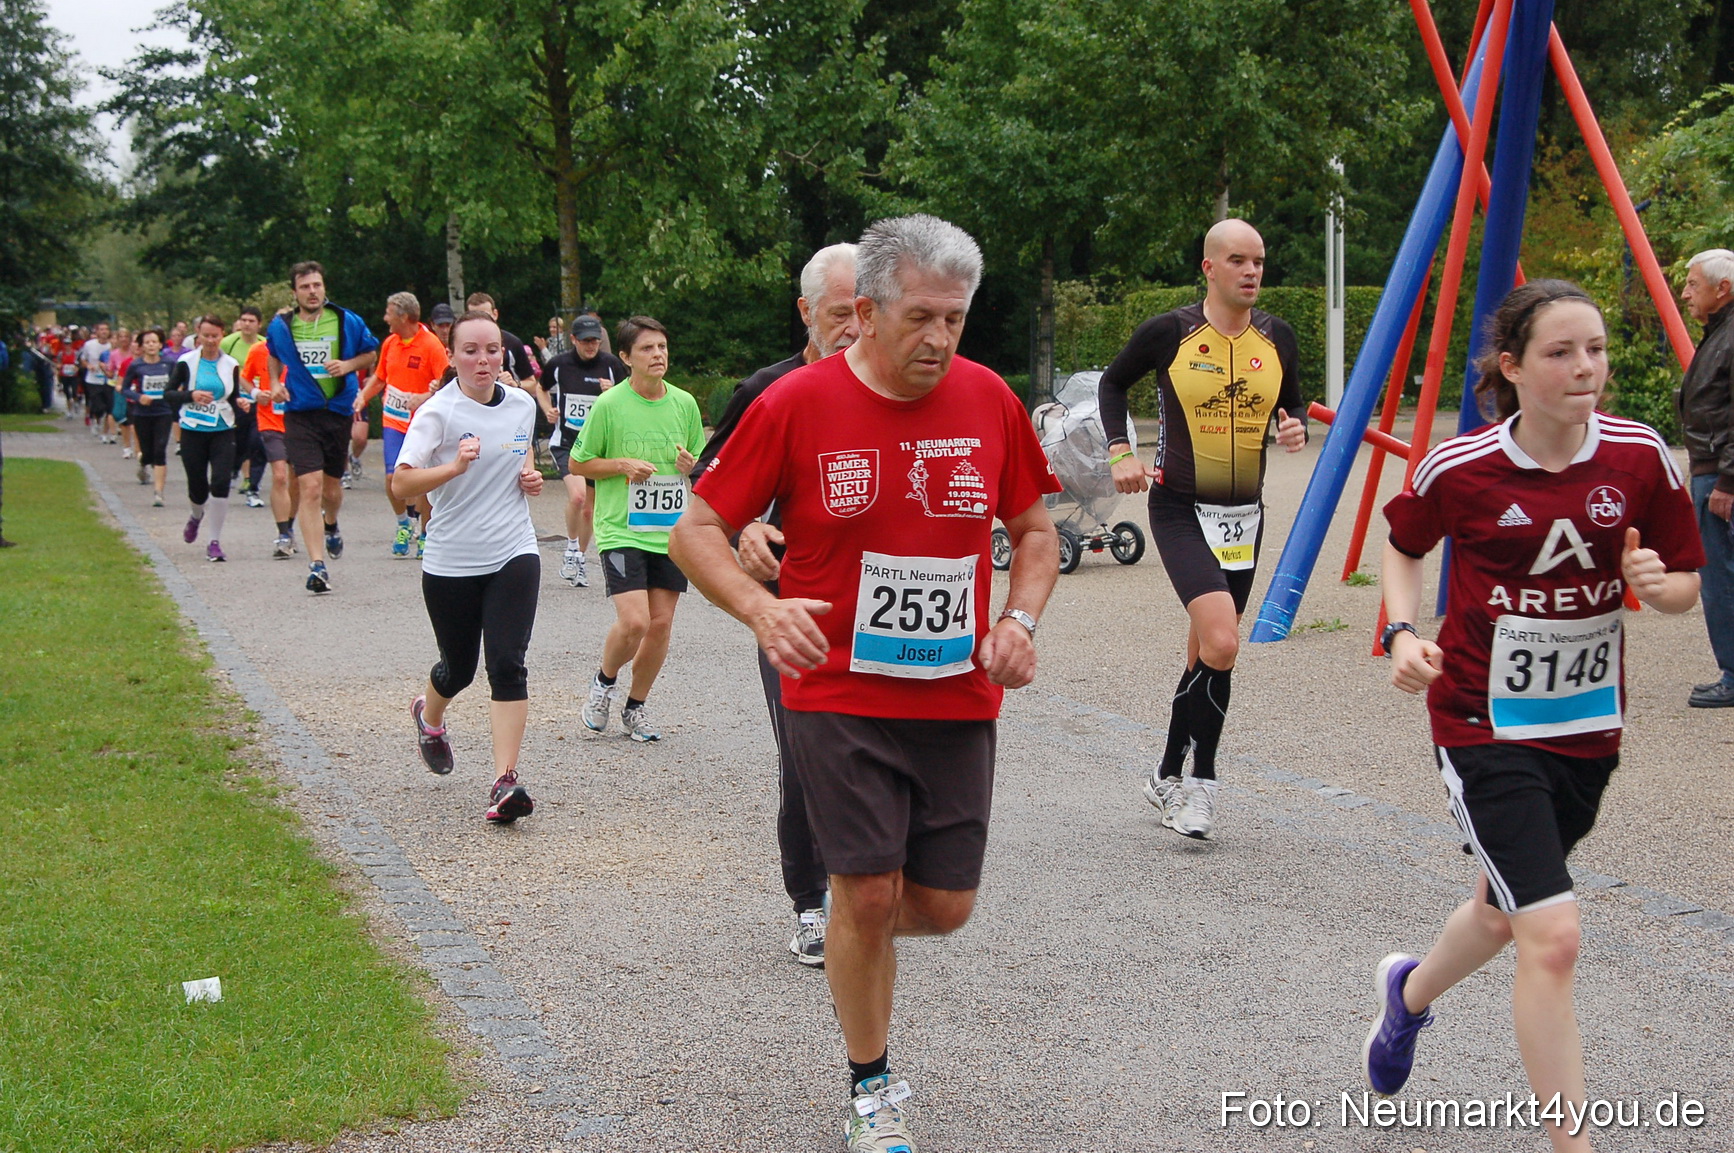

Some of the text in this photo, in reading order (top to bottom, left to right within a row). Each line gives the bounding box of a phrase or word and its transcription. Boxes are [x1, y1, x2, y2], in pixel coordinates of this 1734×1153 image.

[899, 438, 982, 451] 11. NEUMARKTER
[915, 447, 972, 459] STADTLAUF
[828, 459, 870, 472] IMMER
[826, 469, 872, 482] WIEDER
[829, 480, 869, 497] NEU
[635, 489, 683, 510] 3158
[829, 495, 869, 508] MARKT
[1590, 502, 1622, 518] FCN
[1497, 517, 1533, 526] adidas
[1218, 521, 1244, 542] 24
[864, 564, 966, 582] PARTL Neumarkt
[1487, 579, 1622, 613] AREVA
[869, 586, 968, 633] 2534
[1499, 627, 1608, 644] PARTL Neumarkt
[897, 644, 943, 662] Josef
[1505, 641, 1610, 693] 3148
